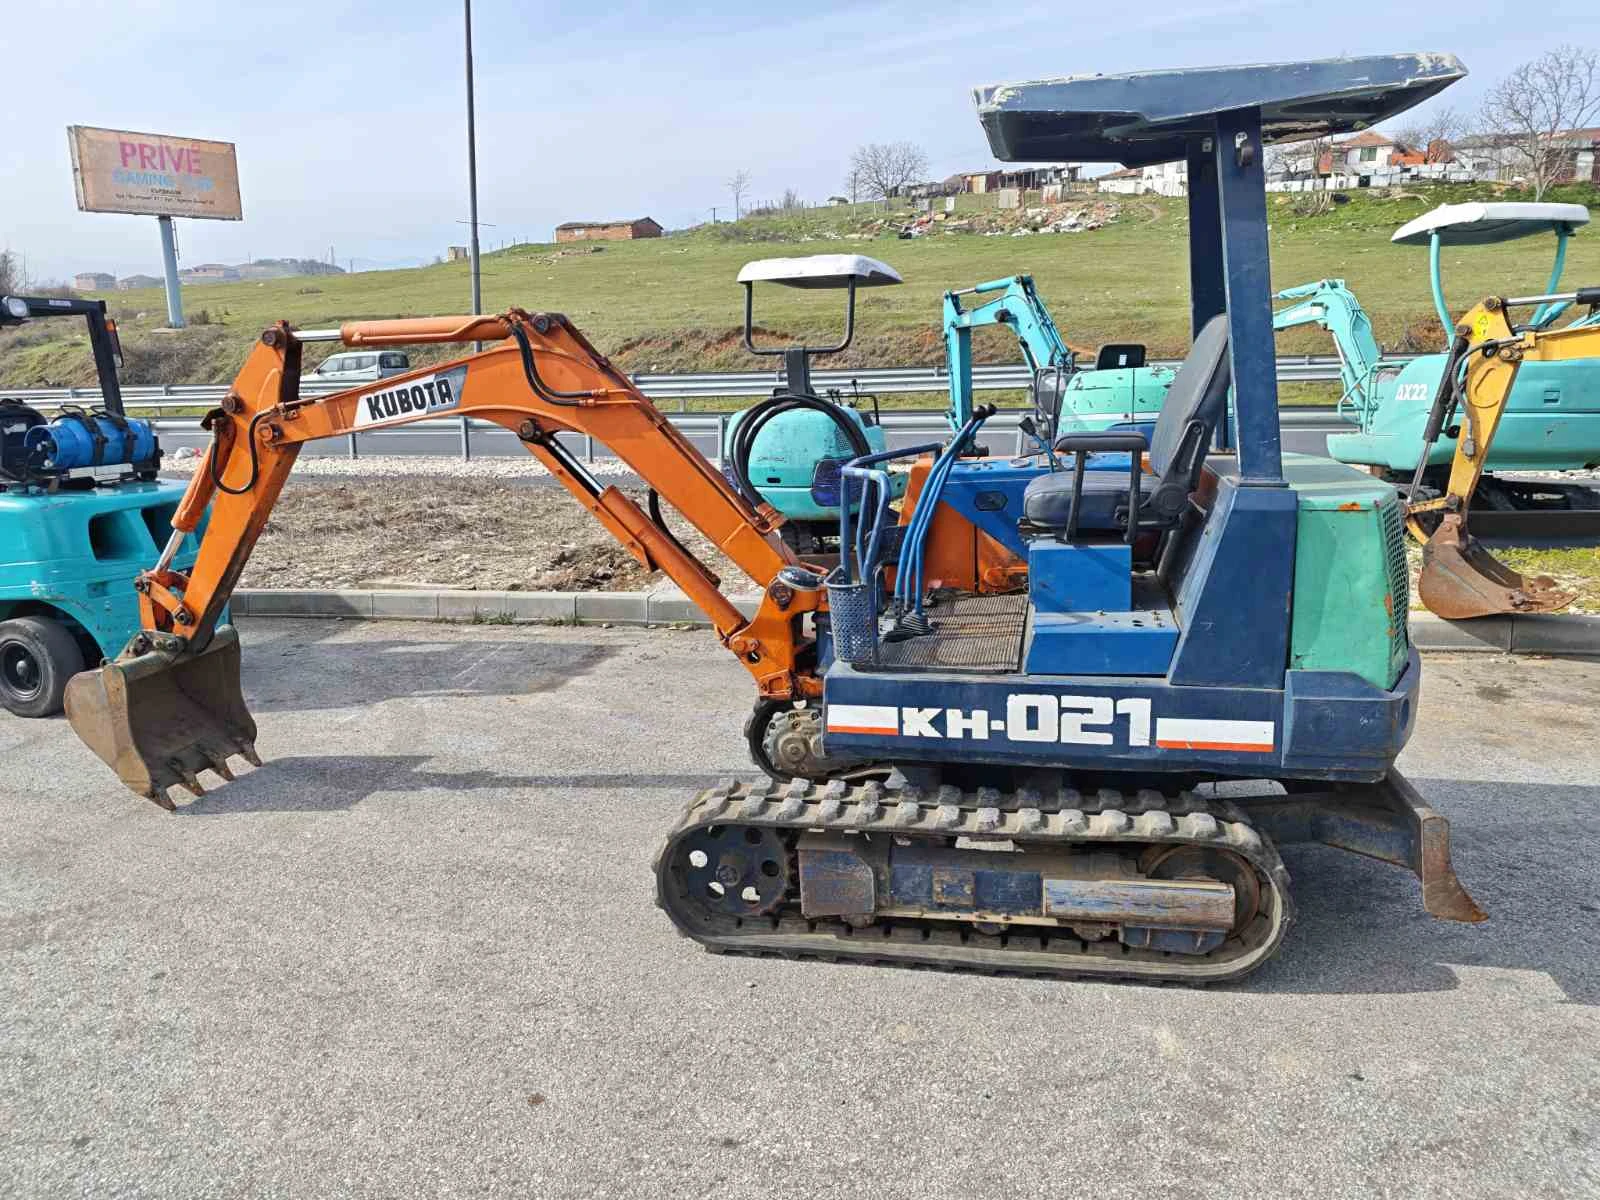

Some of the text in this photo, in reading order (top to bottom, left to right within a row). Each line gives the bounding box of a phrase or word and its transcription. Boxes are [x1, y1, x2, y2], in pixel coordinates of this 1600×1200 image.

[119, 142, 202, 174] PRIVE
[366, 379, 453, 420] KUBOTA
[1394, 383, 1428, 401] AX22
[902, 694, 1152, 746] KH-021
